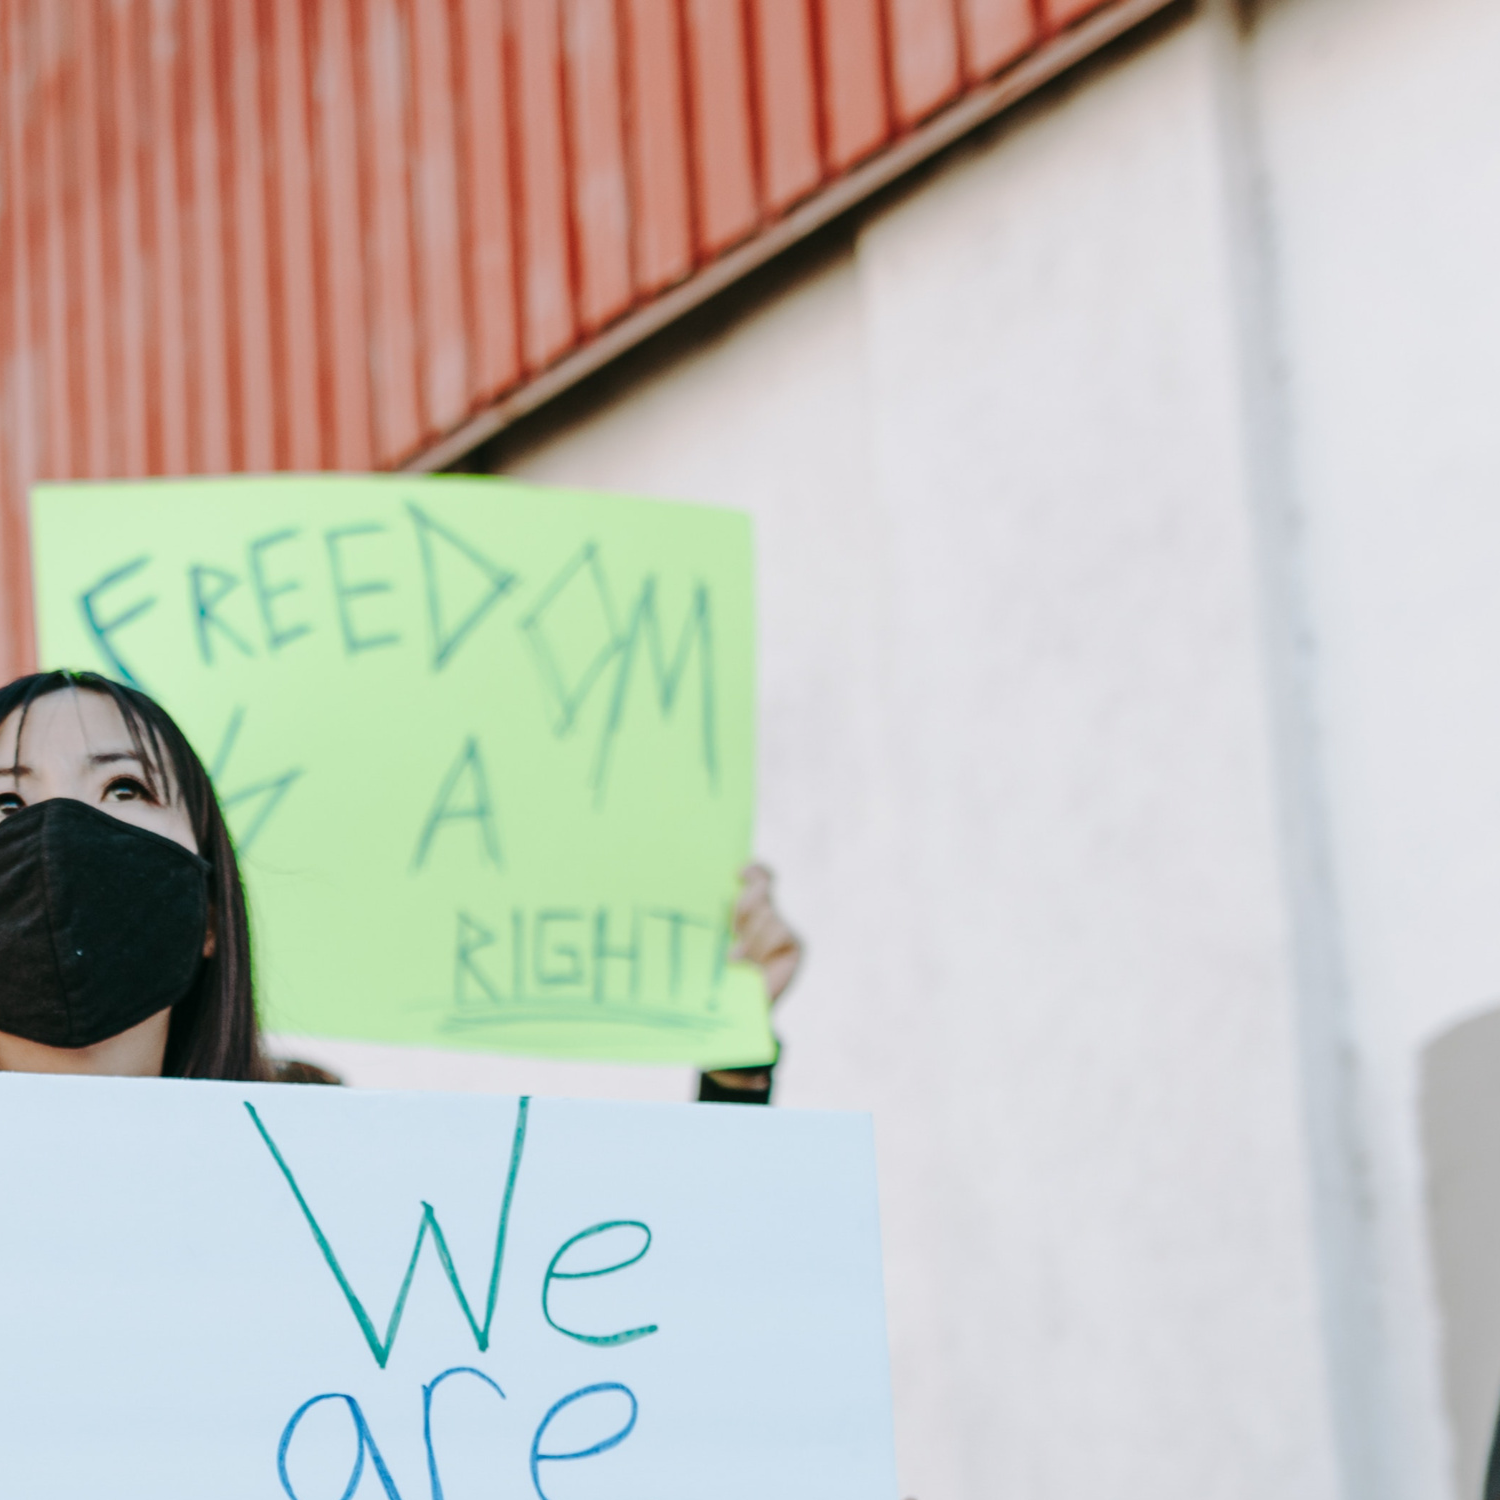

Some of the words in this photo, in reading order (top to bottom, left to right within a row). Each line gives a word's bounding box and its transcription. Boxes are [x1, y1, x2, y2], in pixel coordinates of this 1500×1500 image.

[77, 501, 721, 813] FREEDOM
[410, 733, 503, 873] A
[453, 902, 734, 1013] RIGHT!
[243, 1095, 659, 1368] We
